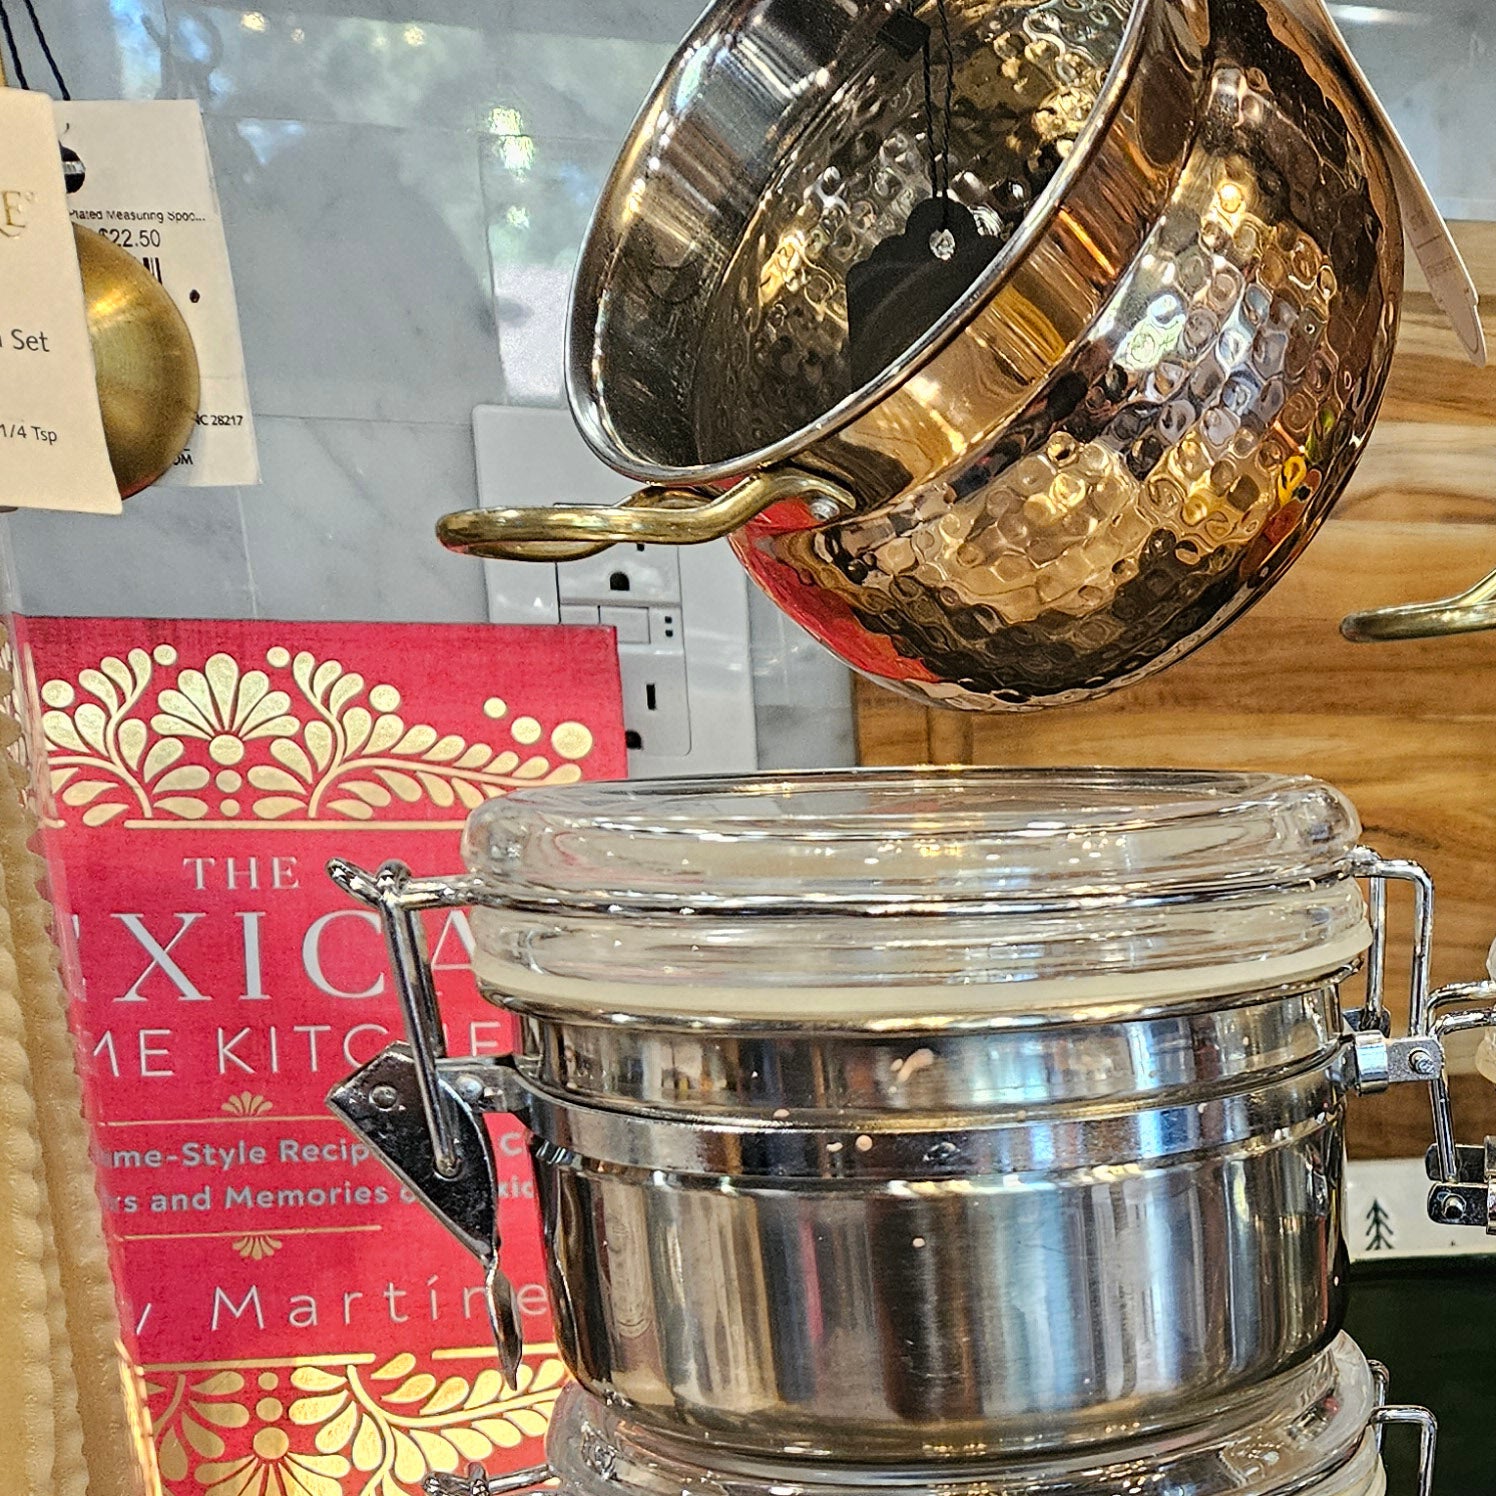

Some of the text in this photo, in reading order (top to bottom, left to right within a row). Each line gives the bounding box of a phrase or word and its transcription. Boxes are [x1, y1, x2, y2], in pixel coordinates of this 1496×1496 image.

[11, 328, 50, 352] Set
[211, 414, 244, 427] 28217
[30, 425, 58, 446] Tsp
[182, 856, 300, 890] THE
[71, 908, 476, 1003] XICA
[150, 1185, 212, 1213] and
[225, 1180, 389, 1209] Memories
